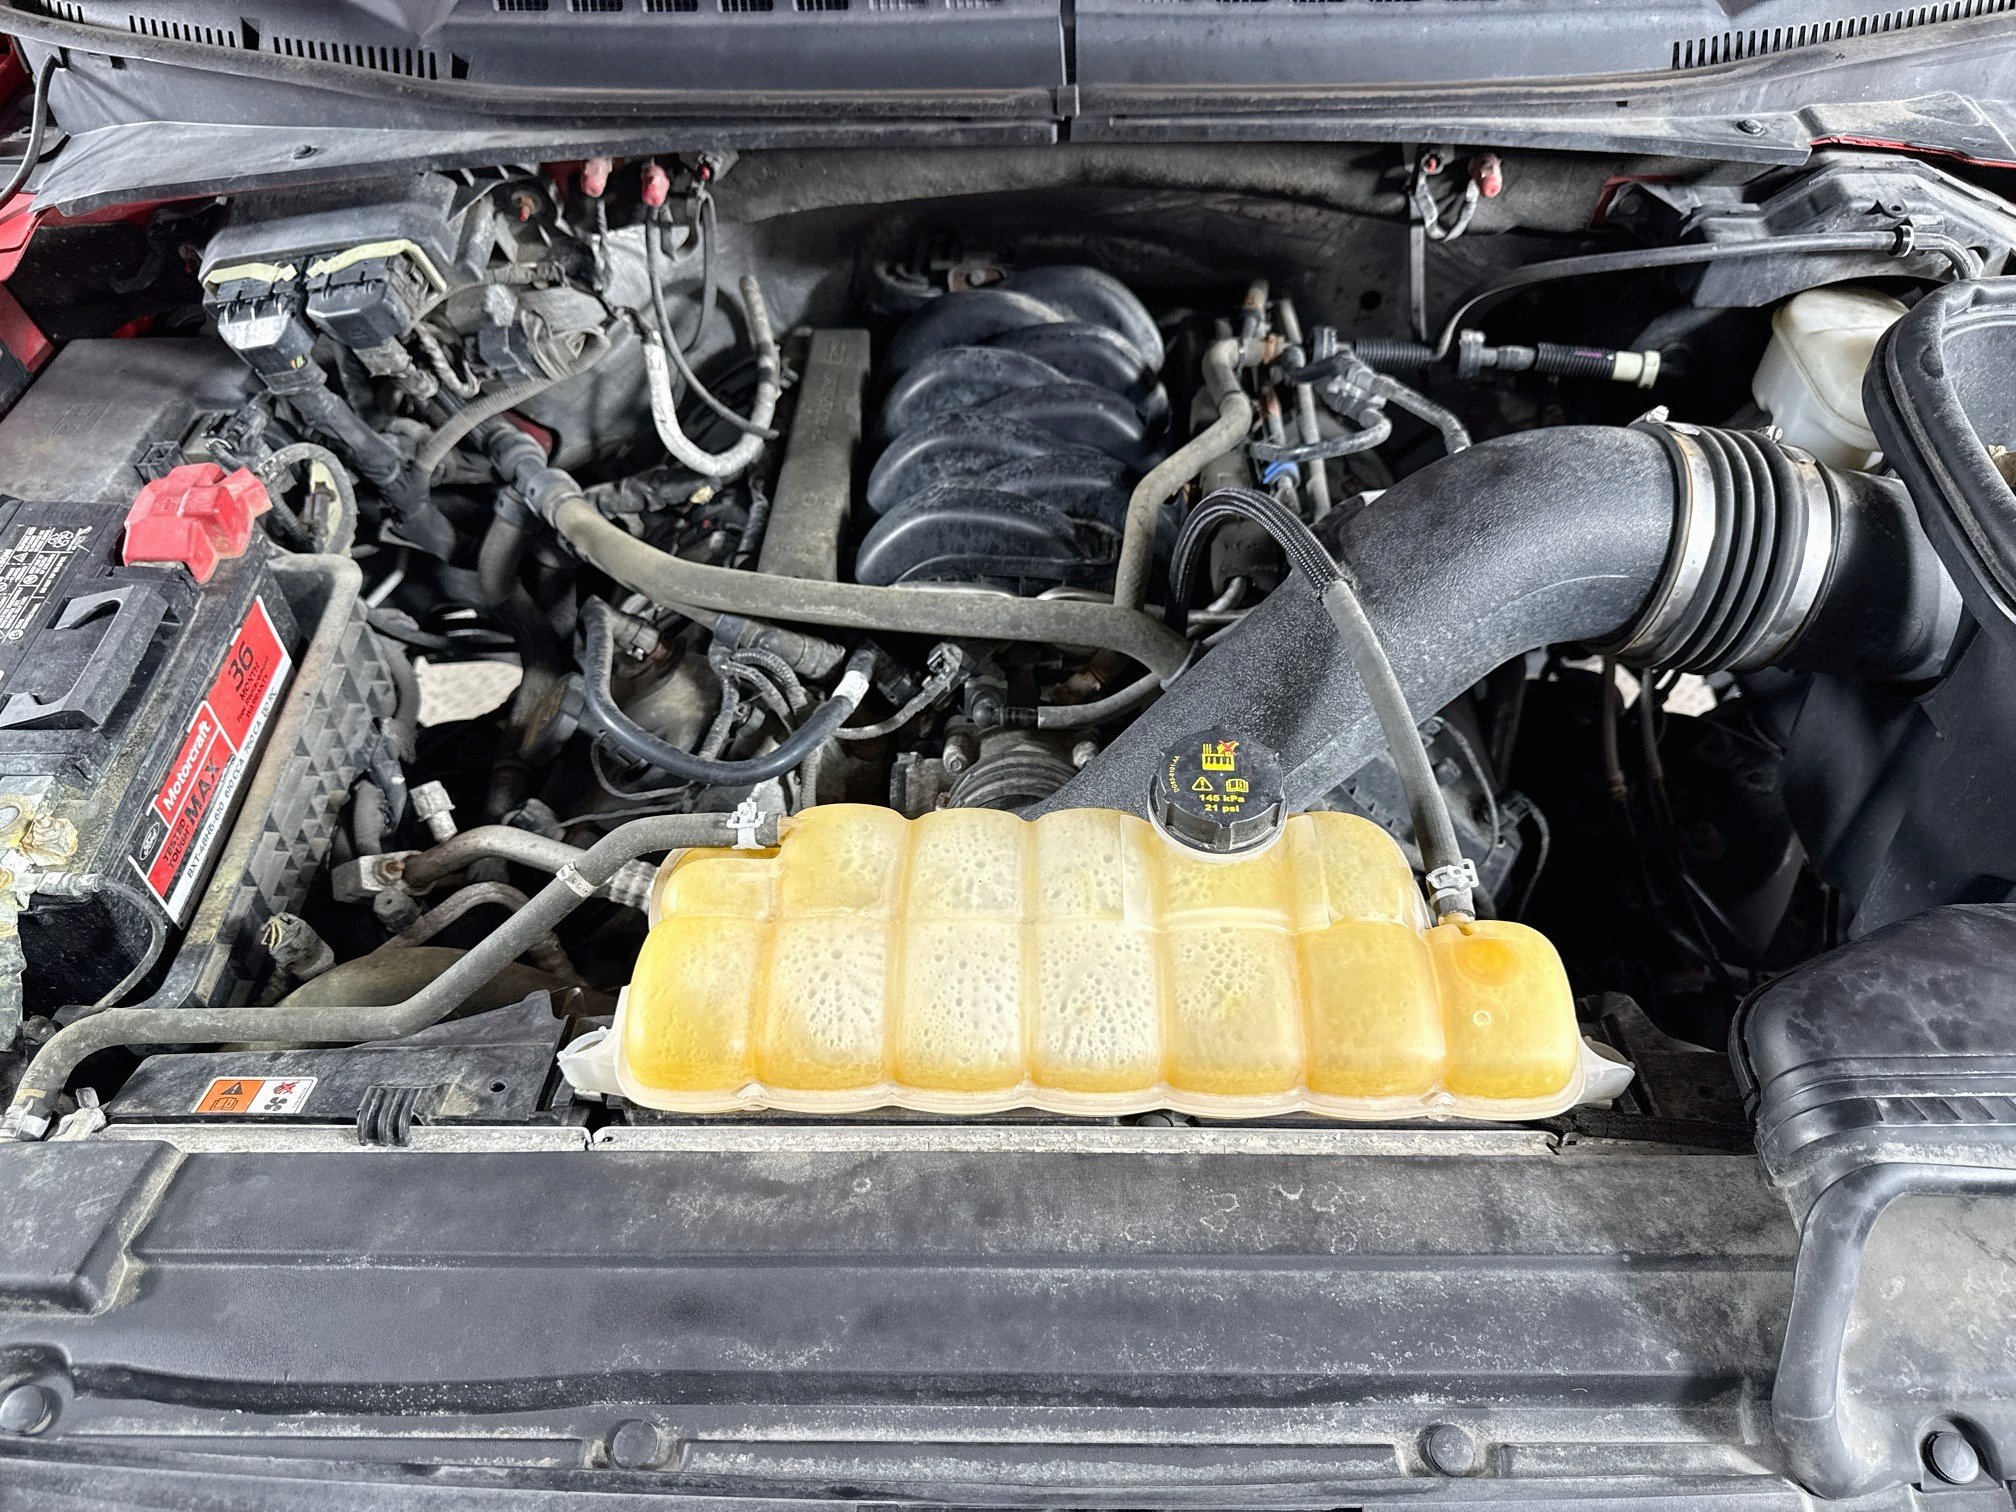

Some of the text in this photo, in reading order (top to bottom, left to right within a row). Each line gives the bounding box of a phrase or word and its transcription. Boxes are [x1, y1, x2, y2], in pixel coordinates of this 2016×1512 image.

[227, 640, 255, 692] 36
[239, 661, 260, 701] MONTH
[246, 674, 269, 719] WARRANTY
[162, 719, 211, 812] Motorcraft
[224, 778, 234, 798] 610
[232, 758, 245, 779] CCA
[252, 720, 263, 739] CA
[184, 755, 220, 826] MAX
[1199, 794, 1245, 803] 145 kPa
[1204, 804, 1240, 813] 21 psi
[142, 825, 159, 858] Ford
[162, 818, 186, 861] TESTED
